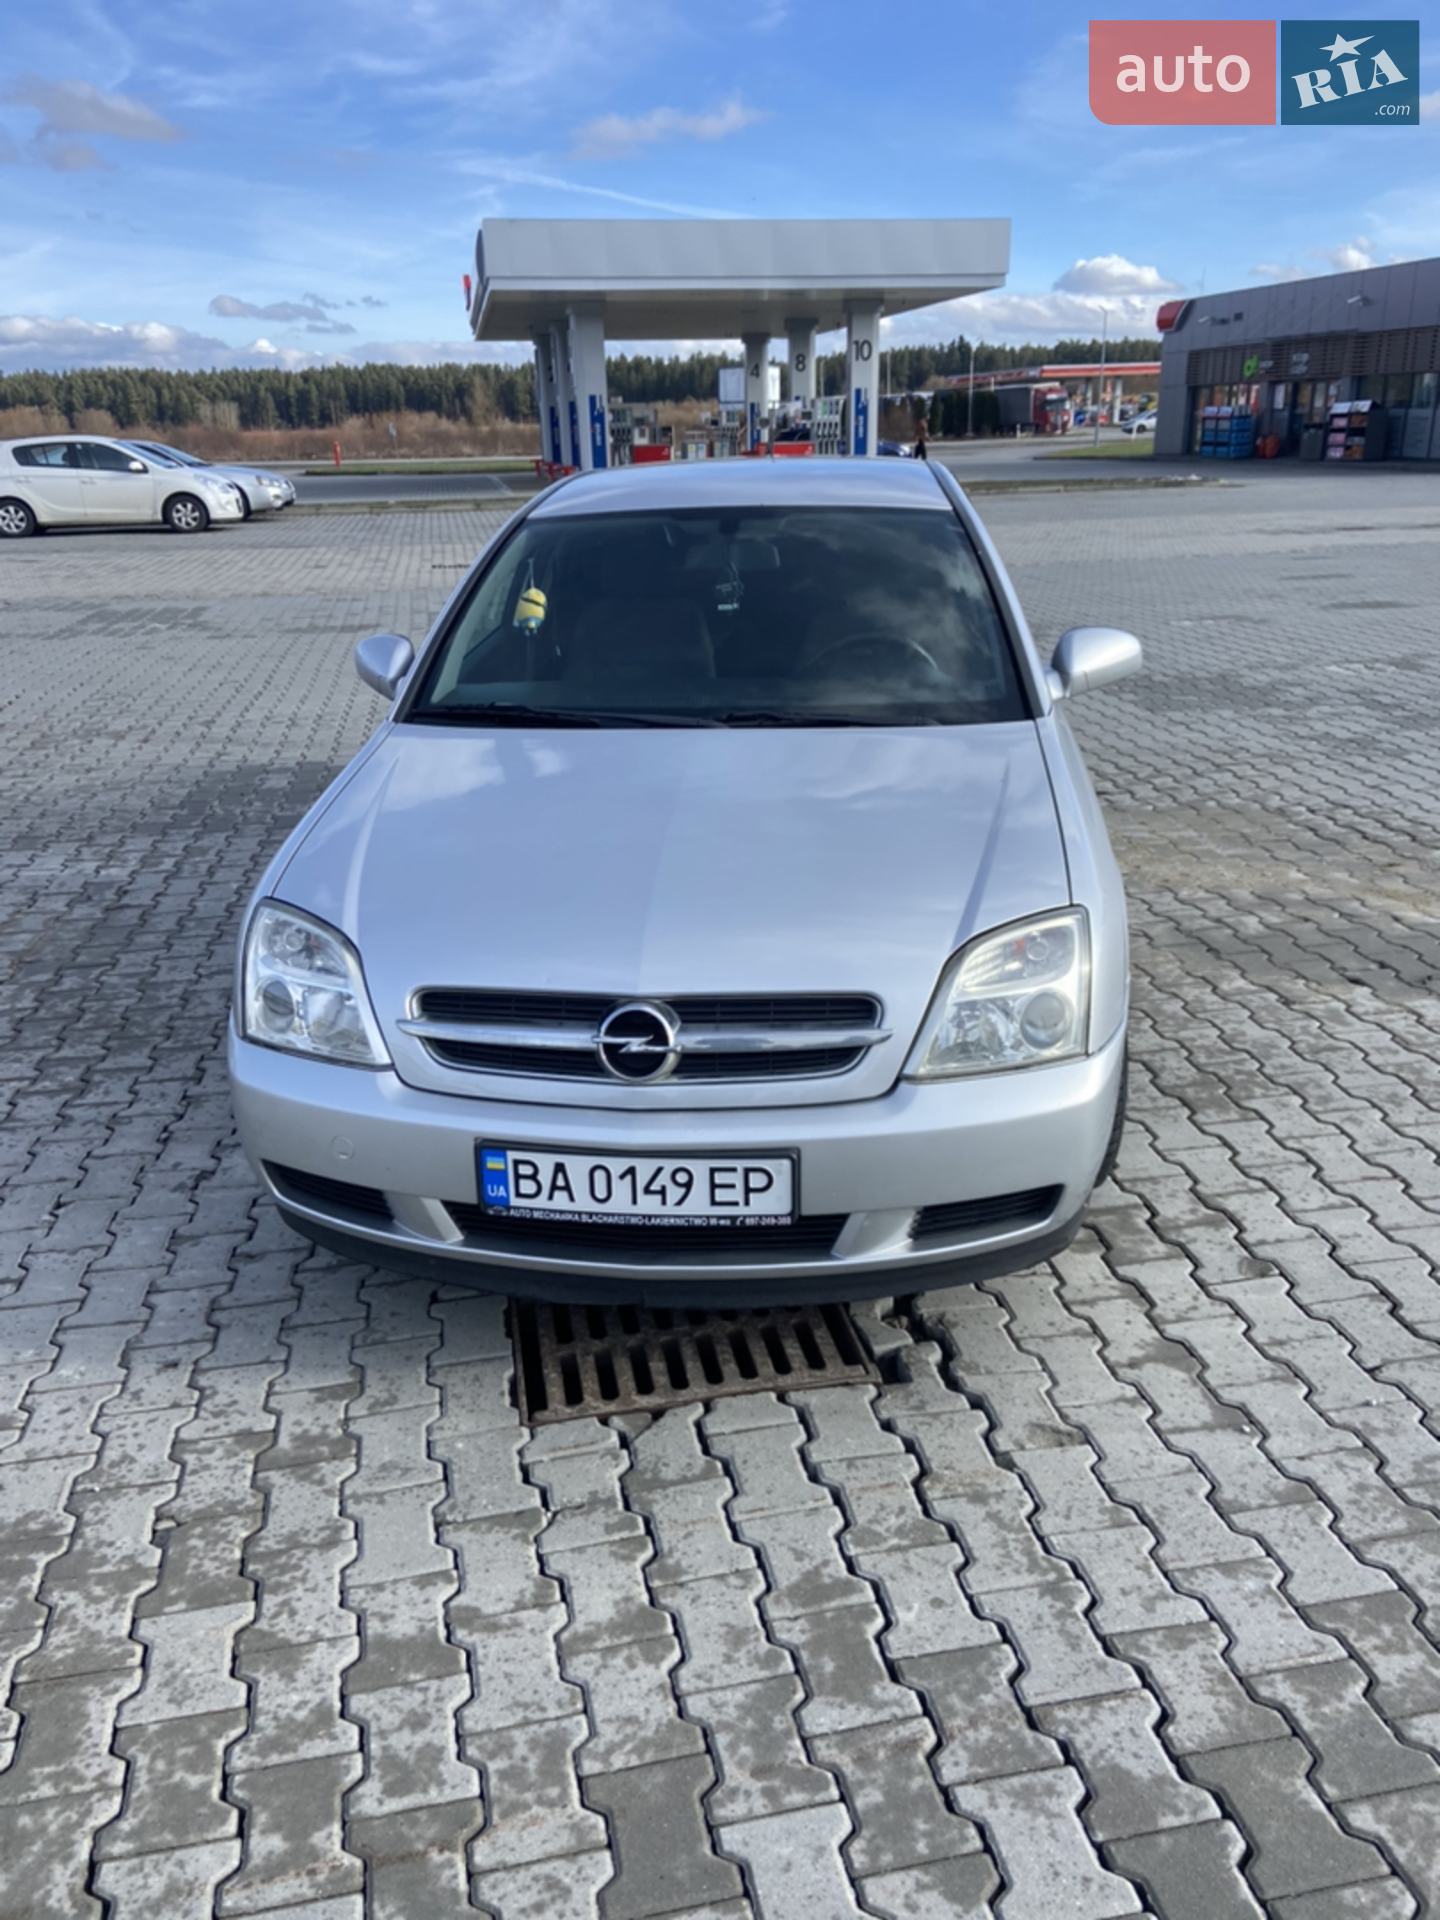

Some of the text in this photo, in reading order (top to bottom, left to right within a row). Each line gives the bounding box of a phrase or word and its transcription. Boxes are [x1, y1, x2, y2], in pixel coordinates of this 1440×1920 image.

[853, 340, 873, 361] 10
[749, 363, 760, 378] 4
[795, 353, 806, 372] 8
[487, 1184, 507, 1198] UA
[512, 1158, 774, 1207] BA 0149 EP
[509, 1208, 532, 1218] AUTO
